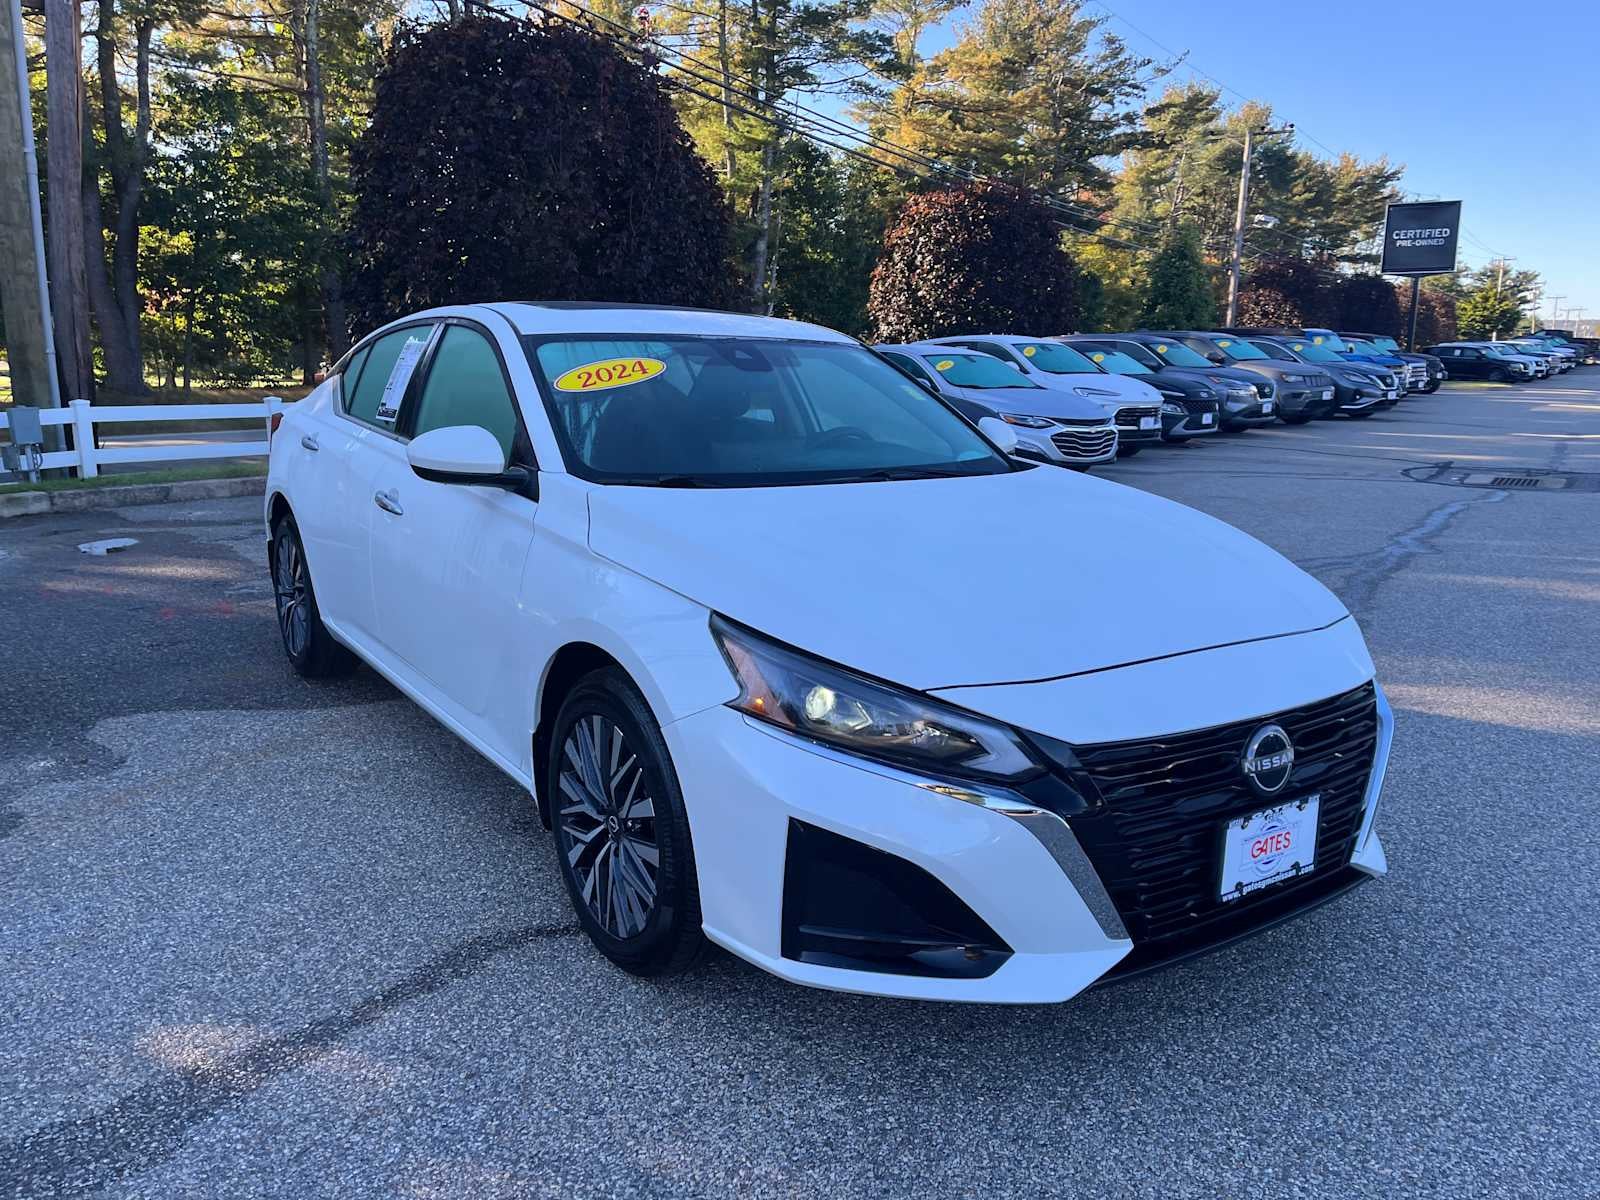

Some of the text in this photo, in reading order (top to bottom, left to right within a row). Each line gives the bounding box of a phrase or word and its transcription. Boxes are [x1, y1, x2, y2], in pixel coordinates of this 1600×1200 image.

[1392, 228, 1450, 239] CERTIFIED
[1396, 238, 1445, 247] PRE-OWNED
[577, 360, 649, 388] 2024
[1251, 831, 1291, 859] GATES
